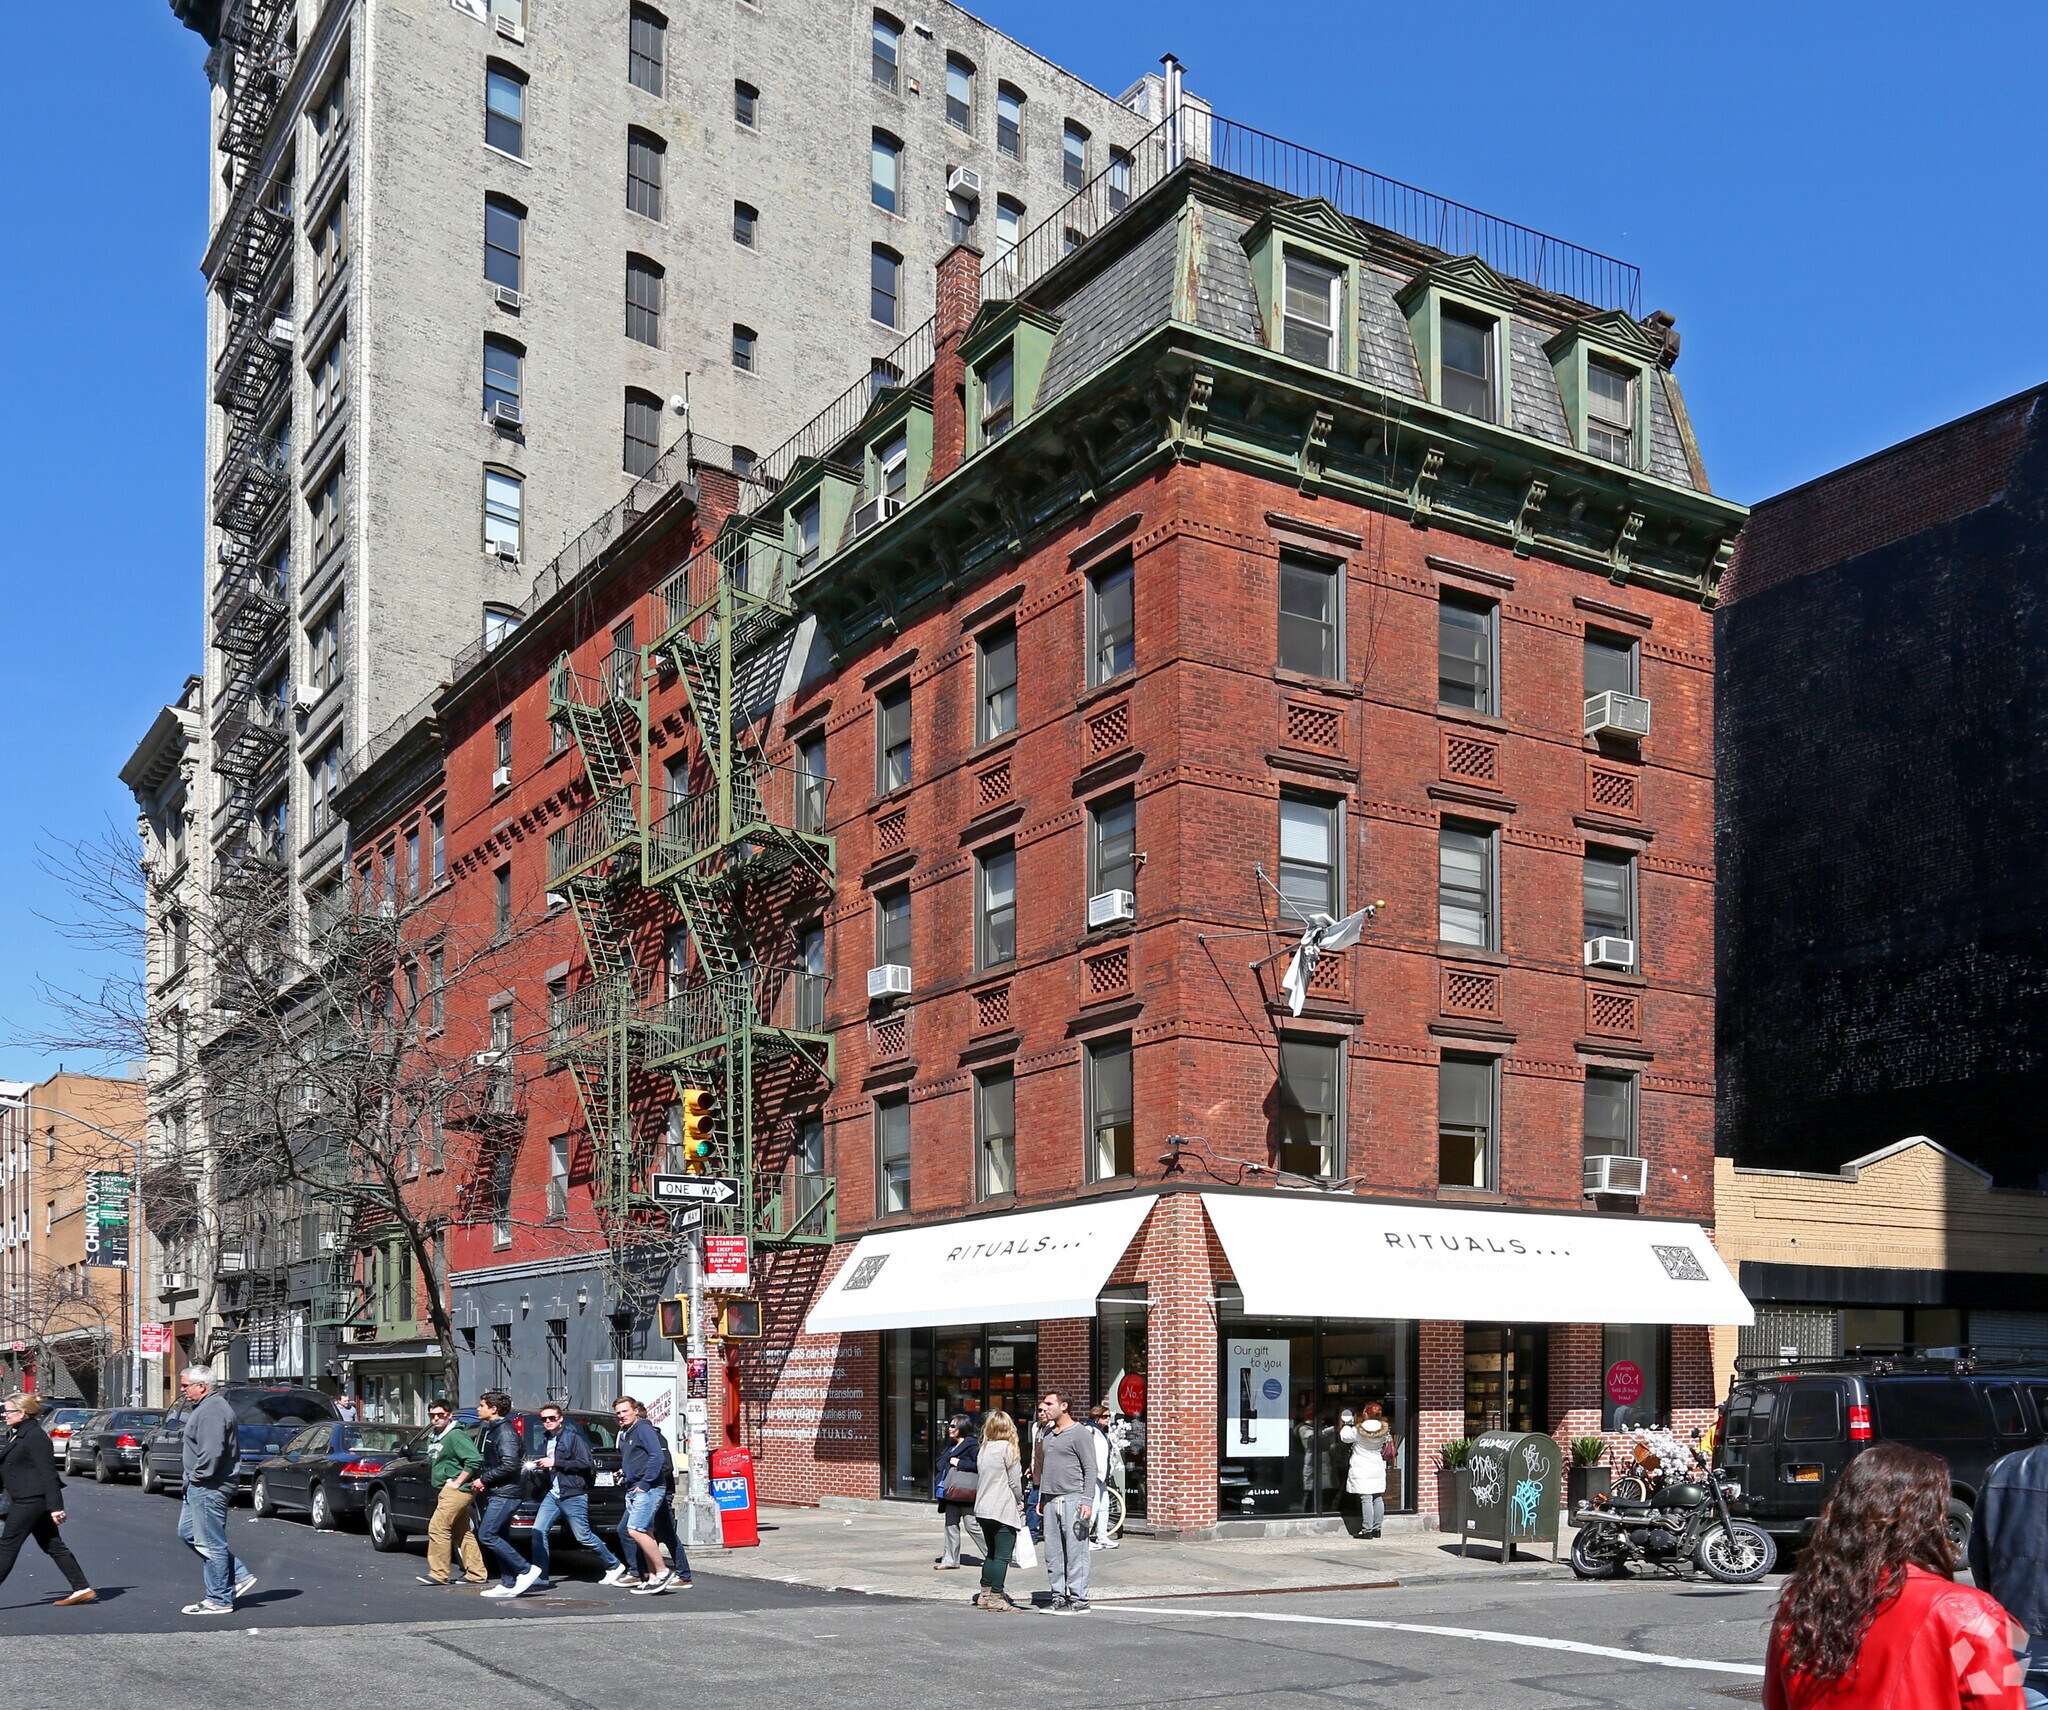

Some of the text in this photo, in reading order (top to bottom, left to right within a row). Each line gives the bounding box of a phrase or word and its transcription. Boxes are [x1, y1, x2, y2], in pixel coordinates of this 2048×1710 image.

[666, 1183, 726, 1197] ONE WAY
[85, 1169, 100, 1253] CHINATOWN
[687, 1209, 699, 1221] WAY
[946, 1236, 1081, 1262] RITUALS...
[1384, 1232, 1570, 1256] RITUALS...
[806, 1349, 819, 1359] can
[820, 1347, 832, 1358] be
[832, 1345, 853, 1358] found
[854, 1345, 862, 1357] in
[1233, 1345, 1269, 1358] Our gift
[1250, 1357, 1282, 1373] to you
[785, 1367, 813, 1378] smallest
[784, 1385, 818, 1402] passion
[829, 1388, 864, 1399] transform
[664, 1396, 672, 1409] AS
[777, 1405, 816, 1423] everyday
[817, 1408, 847, 1420] routines
[848, 1408, 862, 1420] into
[812, 1428, 868, 1440] RITUALS...
[712, 1478, 745, 1492] VOICE
